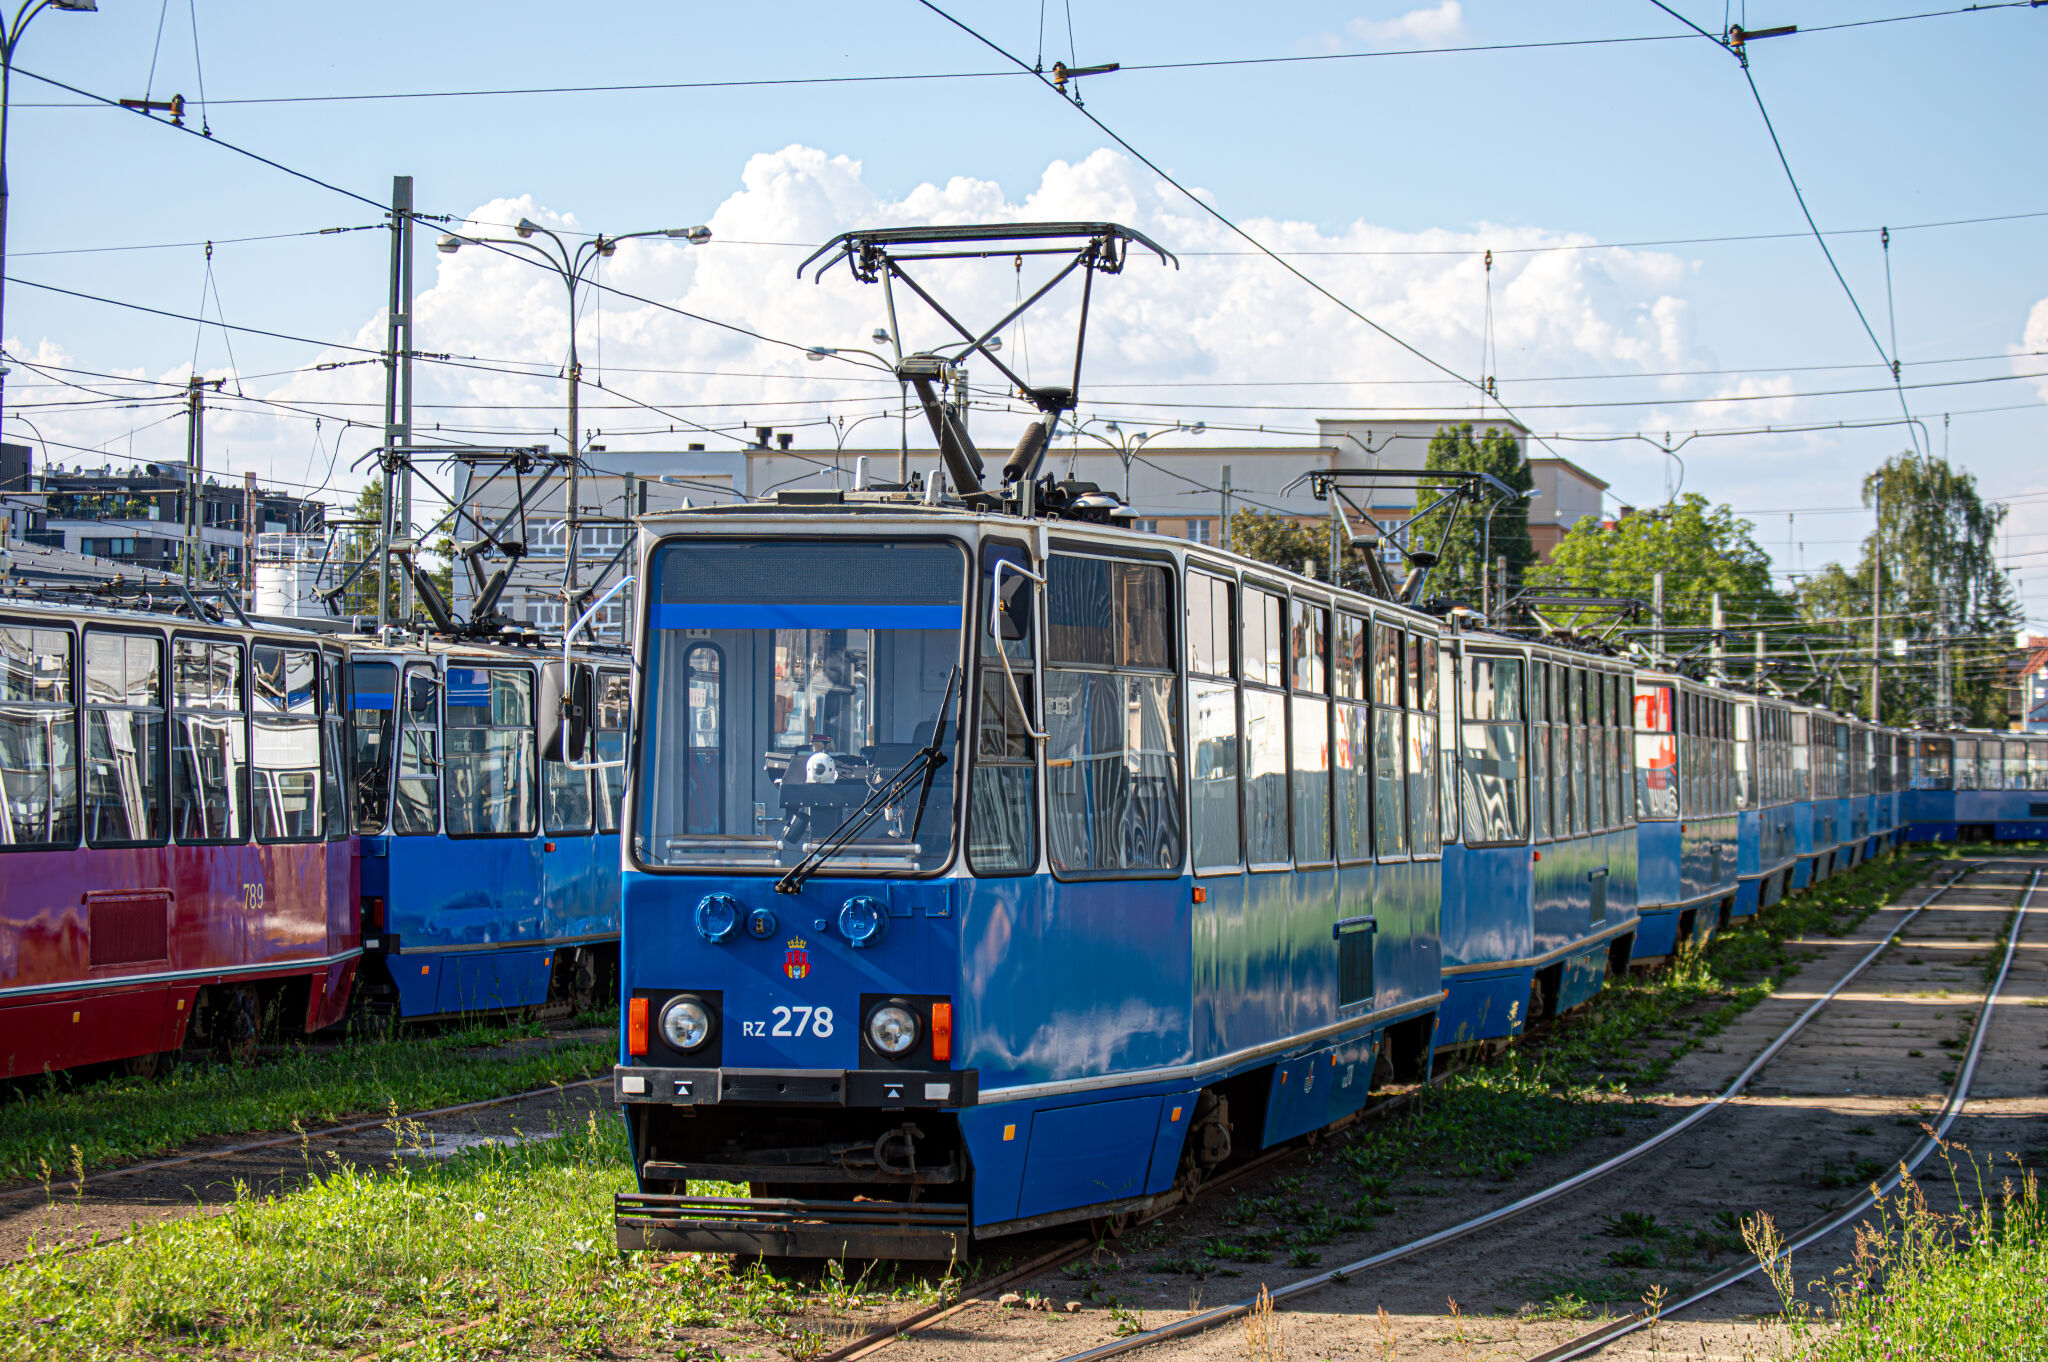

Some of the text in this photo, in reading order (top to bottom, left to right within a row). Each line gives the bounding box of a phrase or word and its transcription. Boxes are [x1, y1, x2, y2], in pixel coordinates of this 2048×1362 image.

[243, 883, 264, 910] 789
[743, 1005, 834, 1038] RZ 278
